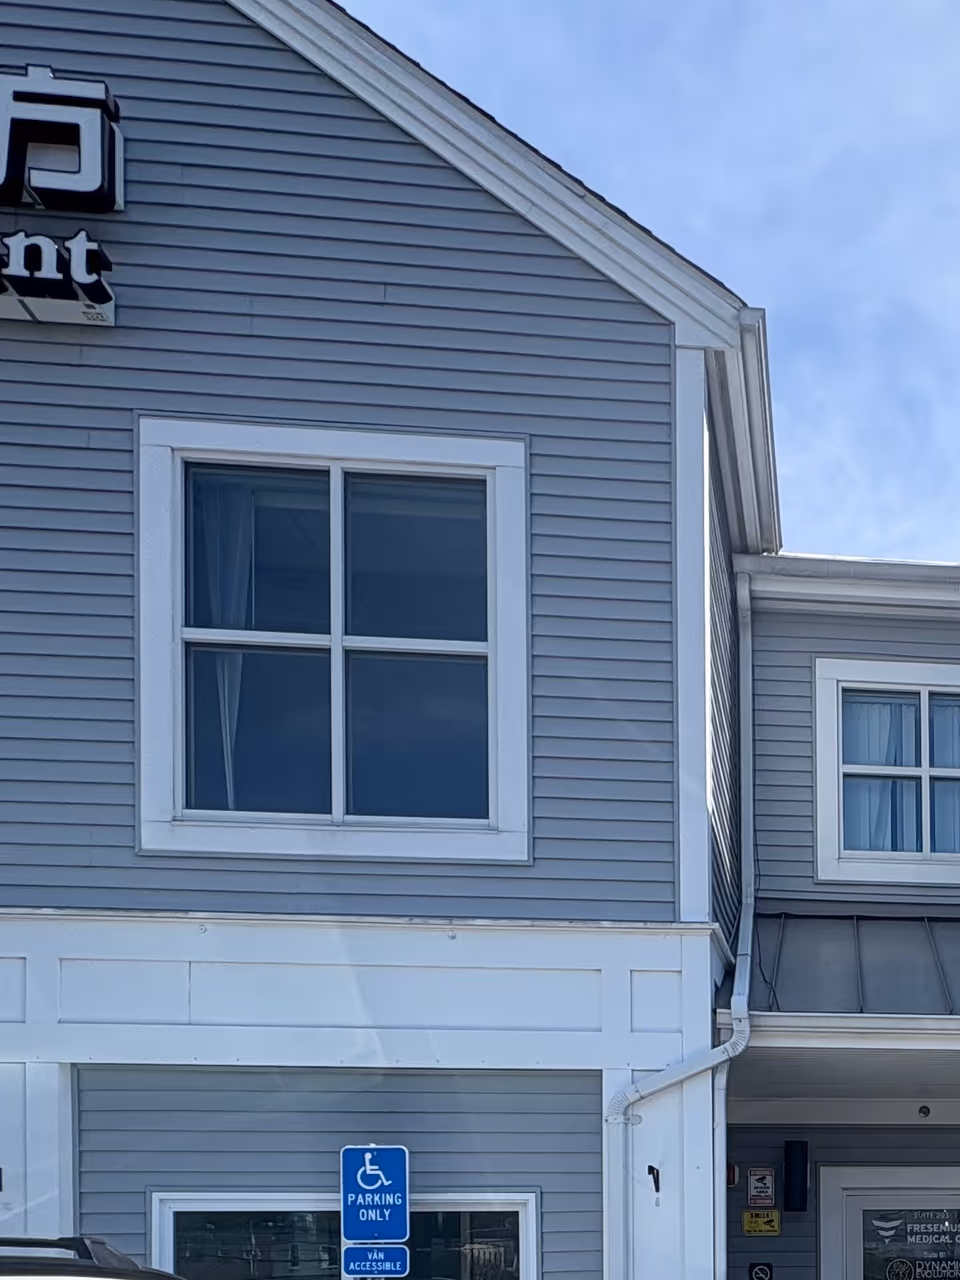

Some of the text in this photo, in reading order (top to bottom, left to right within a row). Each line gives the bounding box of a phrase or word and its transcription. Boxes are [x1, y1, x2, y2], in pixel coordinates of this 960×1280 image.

[347, 1193, 402, 1206] PARKING
[359, 1208, 391, 1221] ONLY
[907, 1234, 953, 1244] MEDICAL
[367, 1251, 385, 1260] VAN
[349, 1261, 402, 1271] ACCESSIBLE
